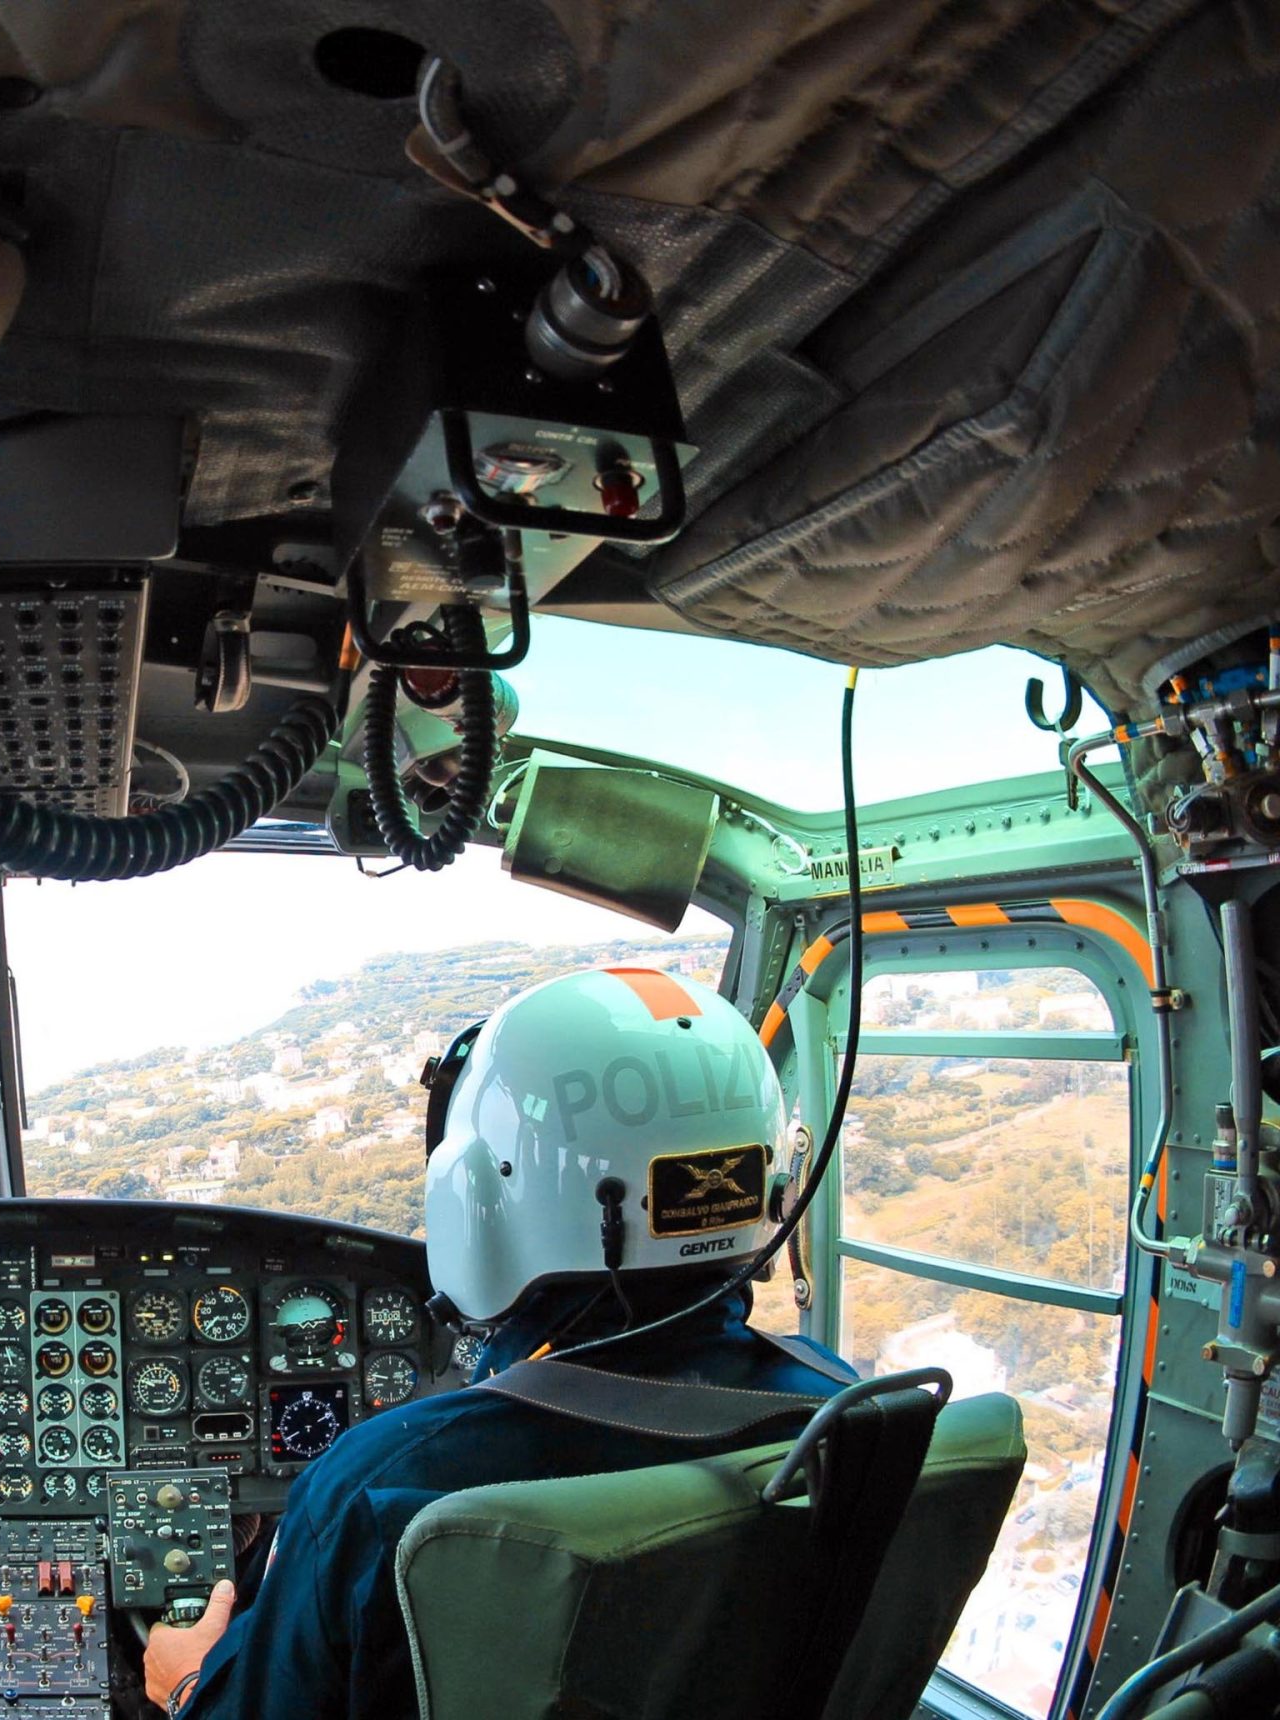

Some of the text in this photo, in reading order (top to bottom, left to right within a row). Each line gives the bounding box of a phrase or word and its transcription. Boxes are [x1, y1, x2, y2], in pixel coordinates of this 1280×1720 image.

[810, 856, 885, 881] MANILIA
[552, 1041, 764, 1144] POLIZI
[680, 1237, 736, 1257] GENTEX
[224, 1295, 234, 1303] 20
[232, 1312, 242, 1321] 40
[212, 1327, 222, 1335] 80
[226, 1322, 236, 1331] 60
